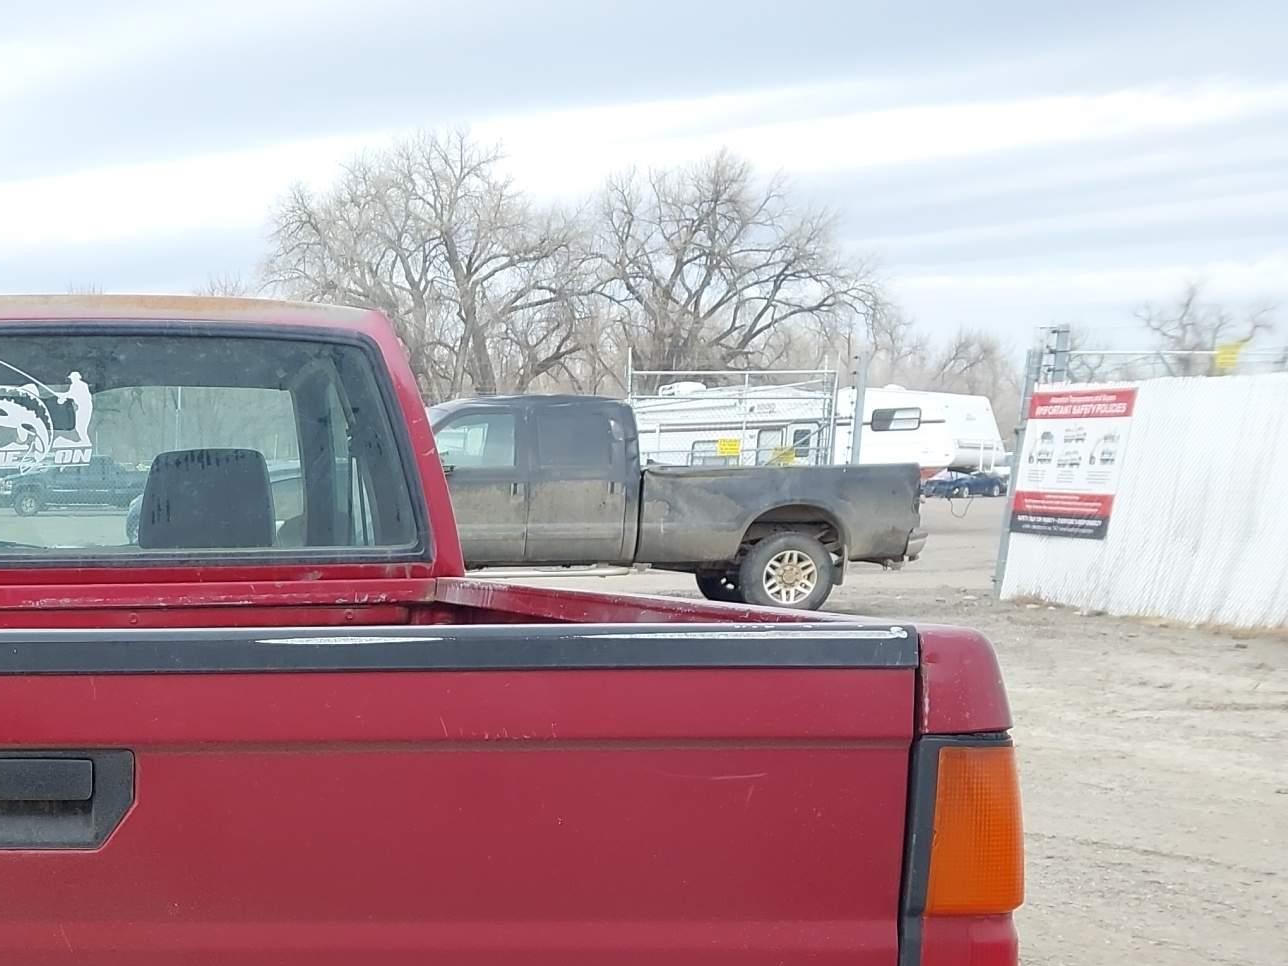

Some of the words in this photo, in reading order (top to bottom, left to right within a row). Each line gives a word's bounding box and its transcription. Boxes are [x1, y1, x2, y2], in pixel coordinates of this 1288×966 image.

[1035, 405, 1072, 416] IMPORTANT
[1072, 403, 1095, 415] SAFETY
[1095, 402, 1128, 414] POLICIES
[54, 448, 93, 464] ON
